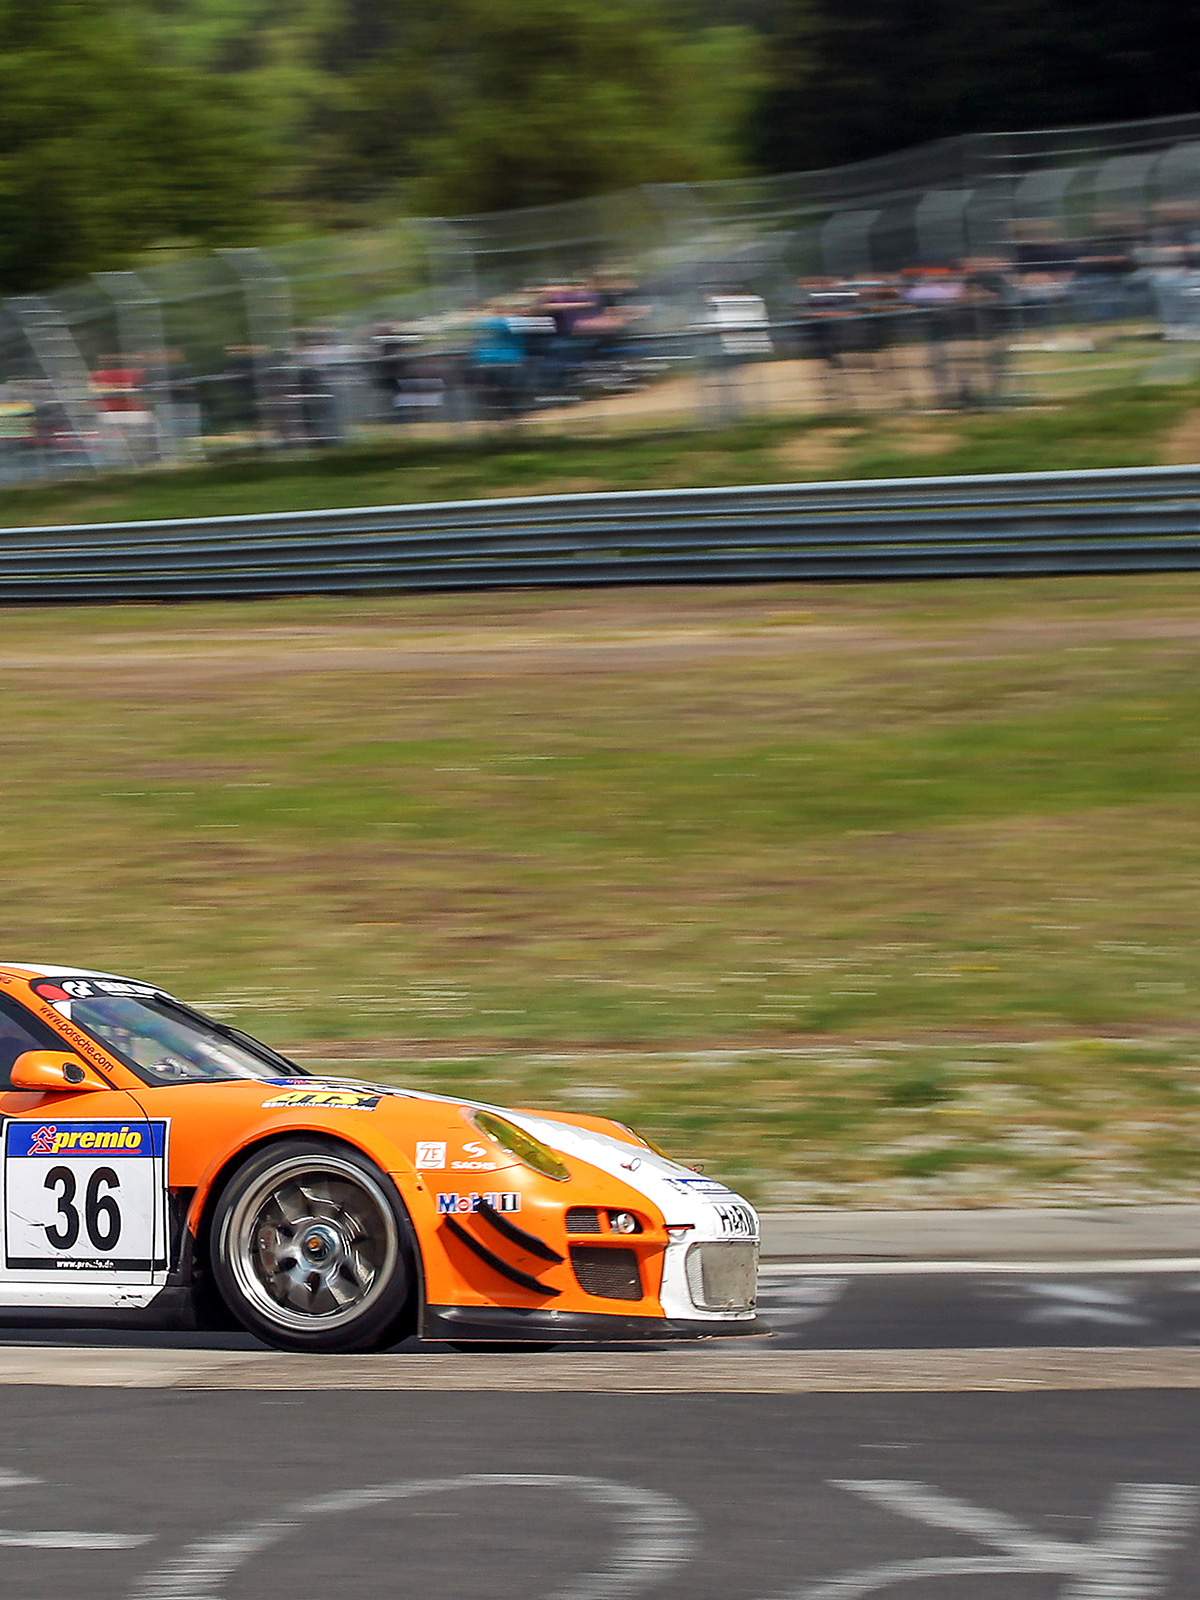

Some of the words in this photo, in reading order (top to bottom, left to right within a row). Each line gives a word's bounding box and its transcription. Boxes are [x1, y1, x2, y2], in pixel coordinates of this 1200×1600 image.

[39, 1004, 114, 1073] www.porsche.com
[52, 1126, 142, 1153] premio
[420, 1147, 442, 1163] ZF
[450, 1160, 498, 1170] SACHS
[43, 1165, 121, 1252] 36
[501, 1193, 518, 1212] 1
